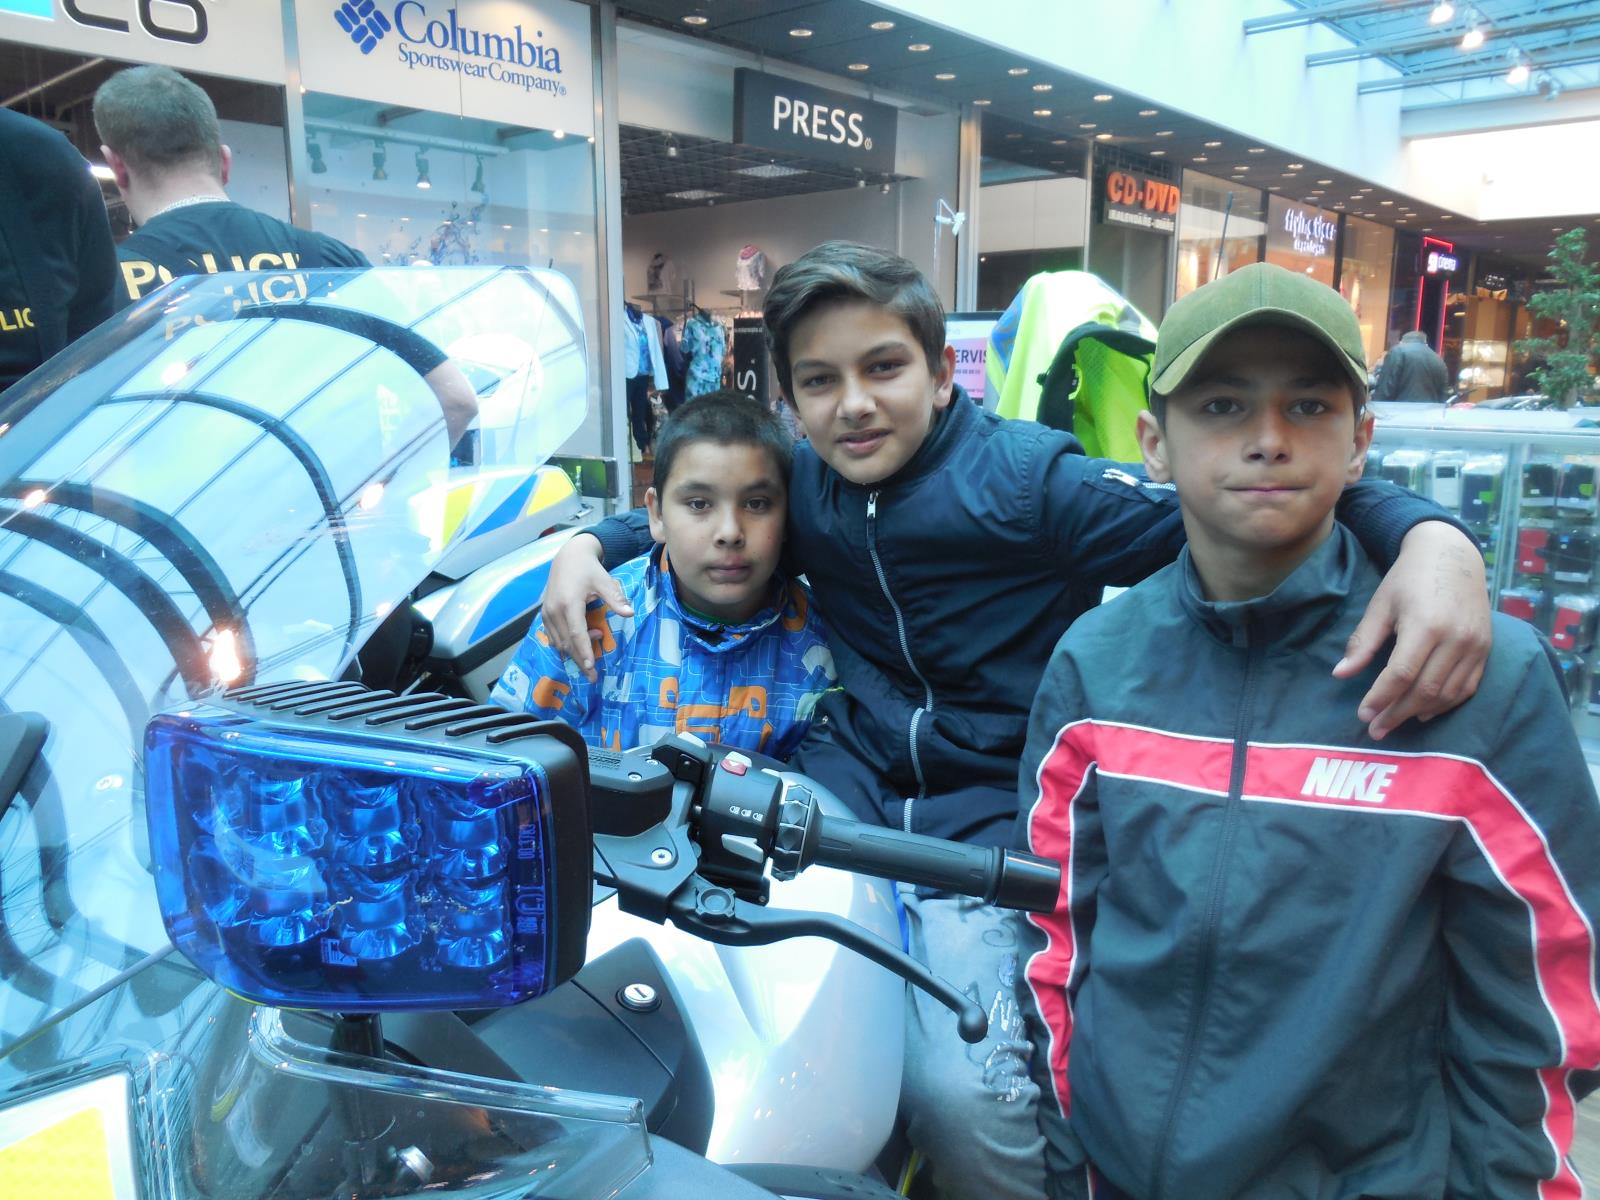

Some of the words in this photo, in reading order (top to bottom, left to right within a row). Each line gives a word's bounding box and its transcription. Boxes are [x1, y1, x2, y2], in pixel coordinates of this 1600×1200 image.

[394, 0, 562, 74] Columbia
[398, 42, 486, 79] Sportswear
[1300, 756, 1398, 803] NIKE
